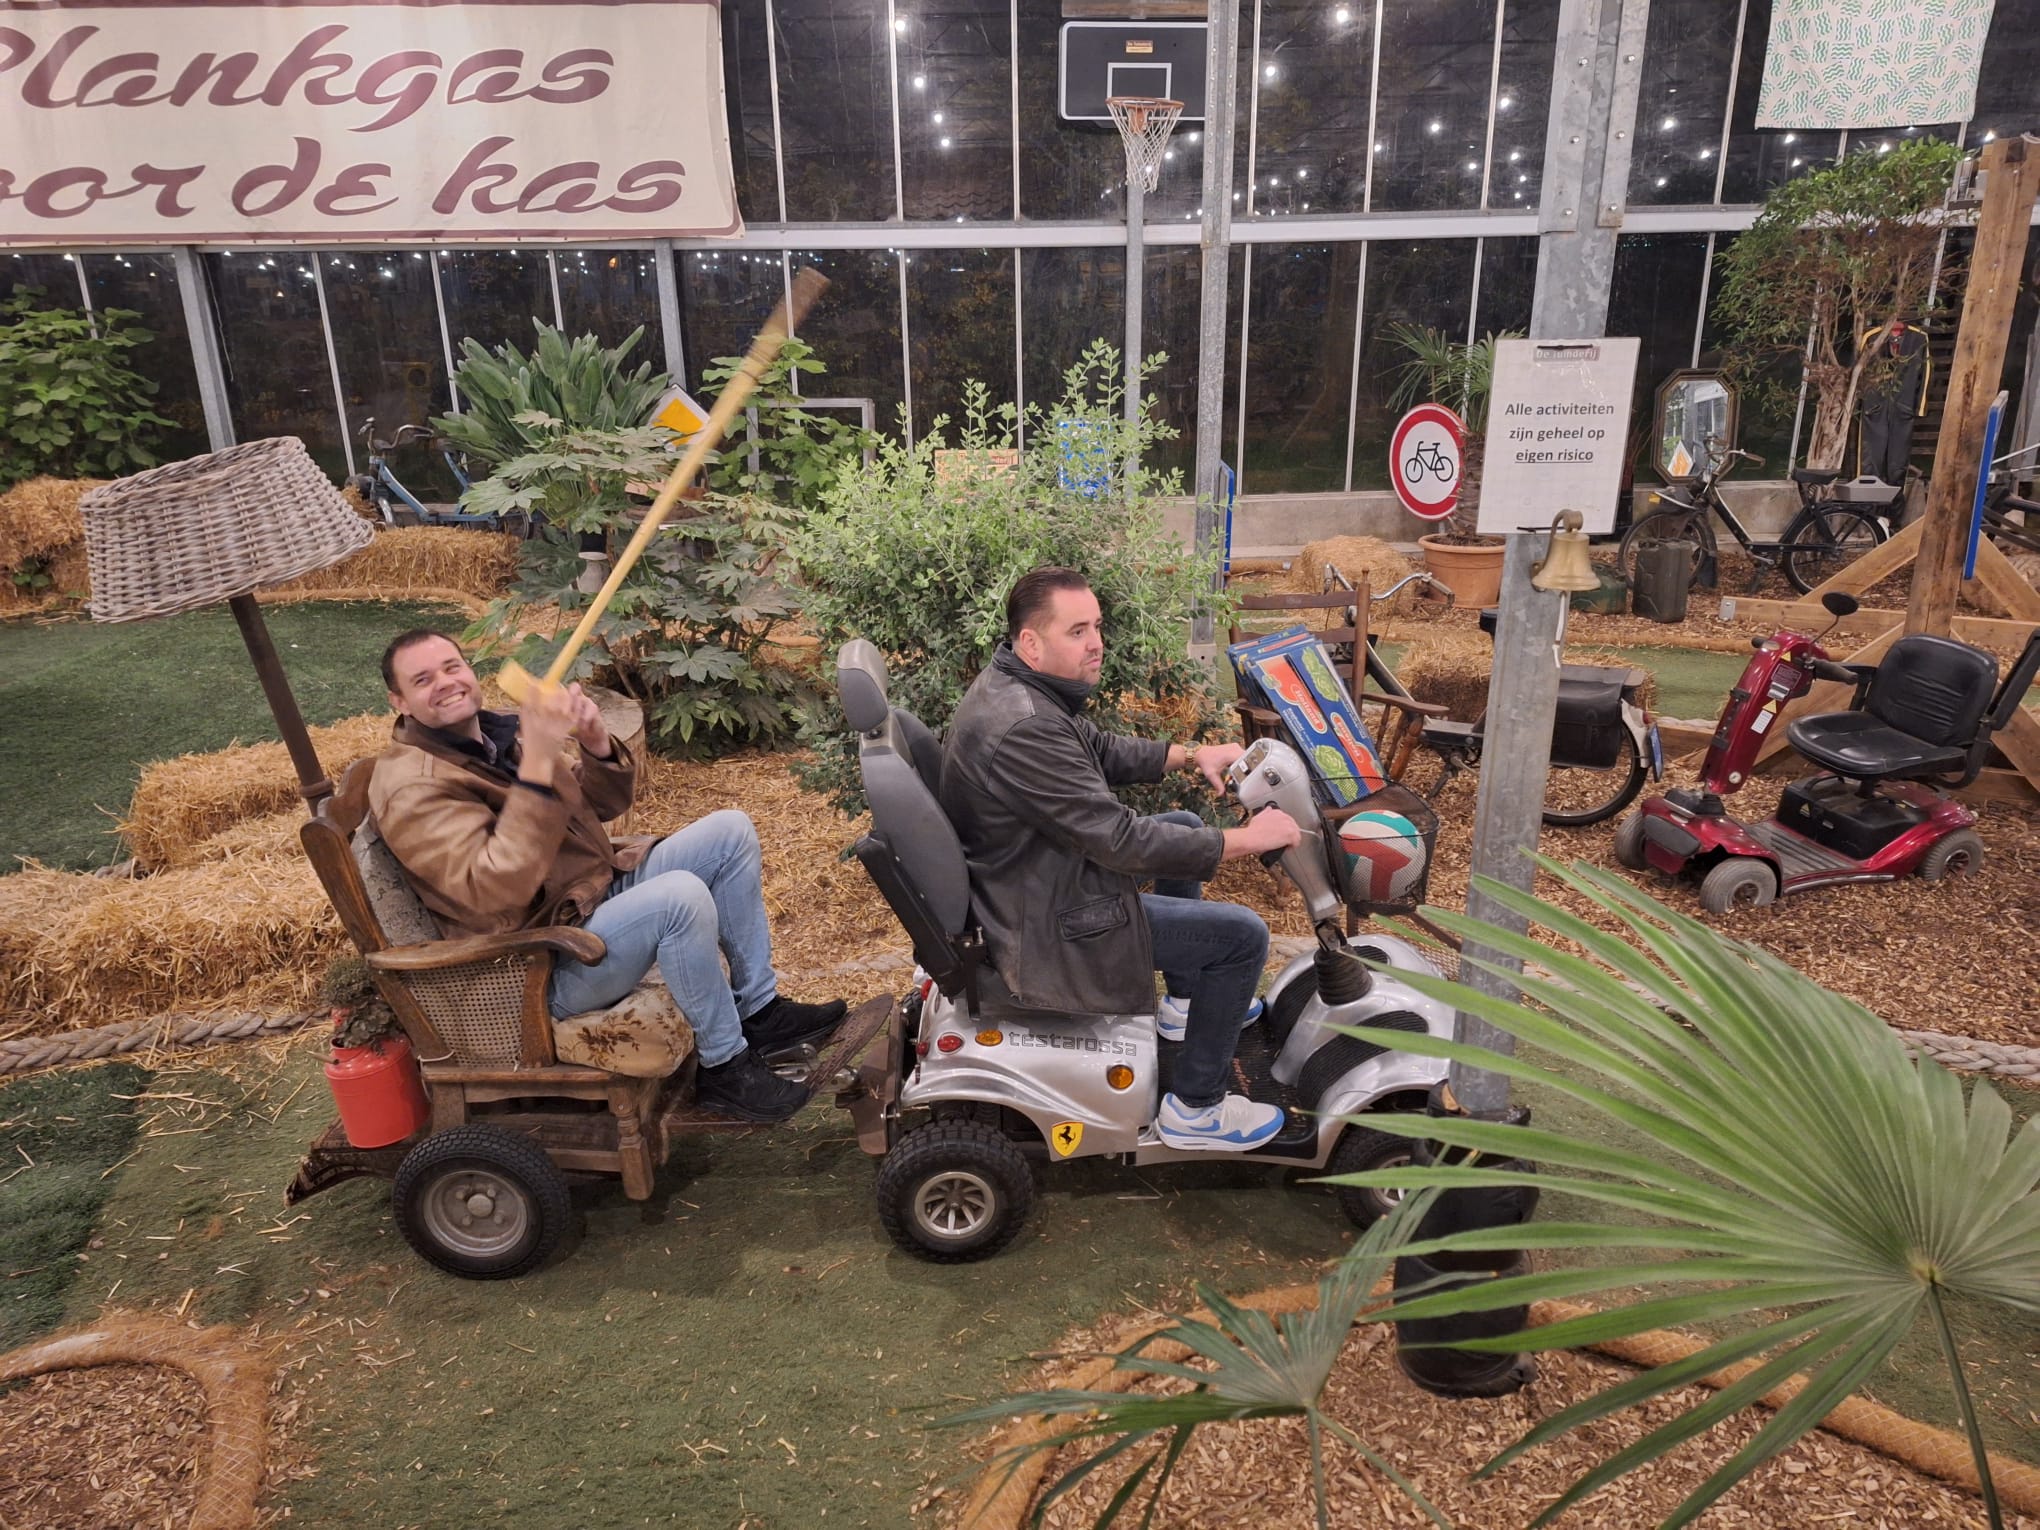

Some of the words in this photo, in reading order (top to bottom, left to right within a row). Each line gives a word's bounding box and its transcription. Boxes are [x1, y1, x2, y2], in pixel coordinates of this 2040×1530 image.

[231, 137, 399, 217] de
[432, 137, 686, 214] kas
[1505, 403, 1533, 416] Alle
[1536, 402, 1615, 416] activiteiten
[1509, 427, 1534, 442] zijn
[1537, 426, 1584, 442] geheel
[1587, 429, 1606, 441] op
[1516, 449, 1553, 463] eigen
[1557, 449, 1594, 461] risico
[1009, 1031, 1137, 1057] testarossa
